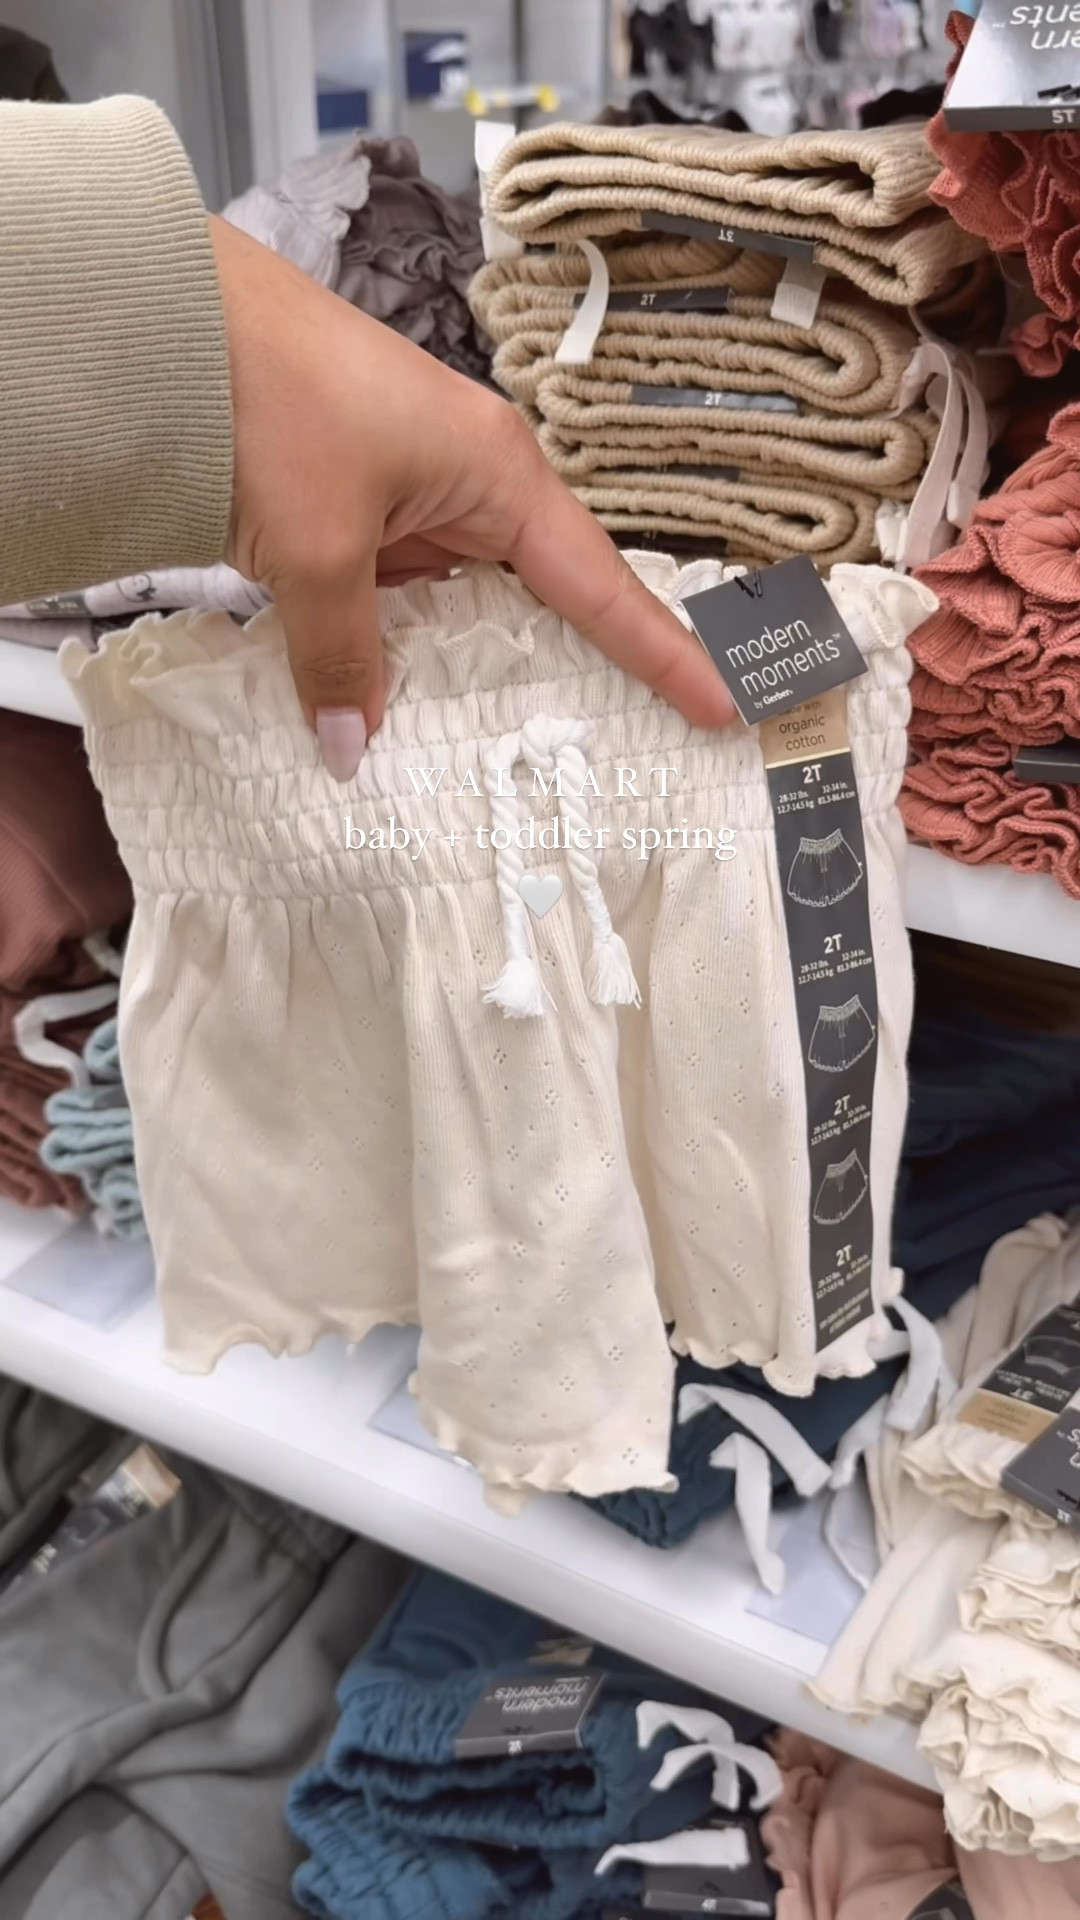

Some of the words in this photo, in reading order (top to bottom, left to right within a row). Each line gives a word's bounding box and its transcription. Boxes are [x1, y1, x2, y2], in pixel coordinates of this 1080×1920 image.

[1051, 109, 1076, 124] 5T
[718, 229, 734, 242] 3T
[640, 294, 656, 305] 2T
[704, 393, 722, 405] 2T
[726, 620, 812, 668] modern
[740, 639, 840, 695] moments
[753, 701, 764, 709] by
[779, 715, 826, 734] organic
[785, 734, 826, 751] cotton
[802, 764, 822, 784] 2T
[805, 799, 815, 809] kg
[824, 934, 842, 954] 2T
[834, 1095, 850, 1115] 2T
[836, 1244, 852, 1266] 2T
[495, 1682, 588, 1698] moments
[502, 1696, 580, 1711] modern
